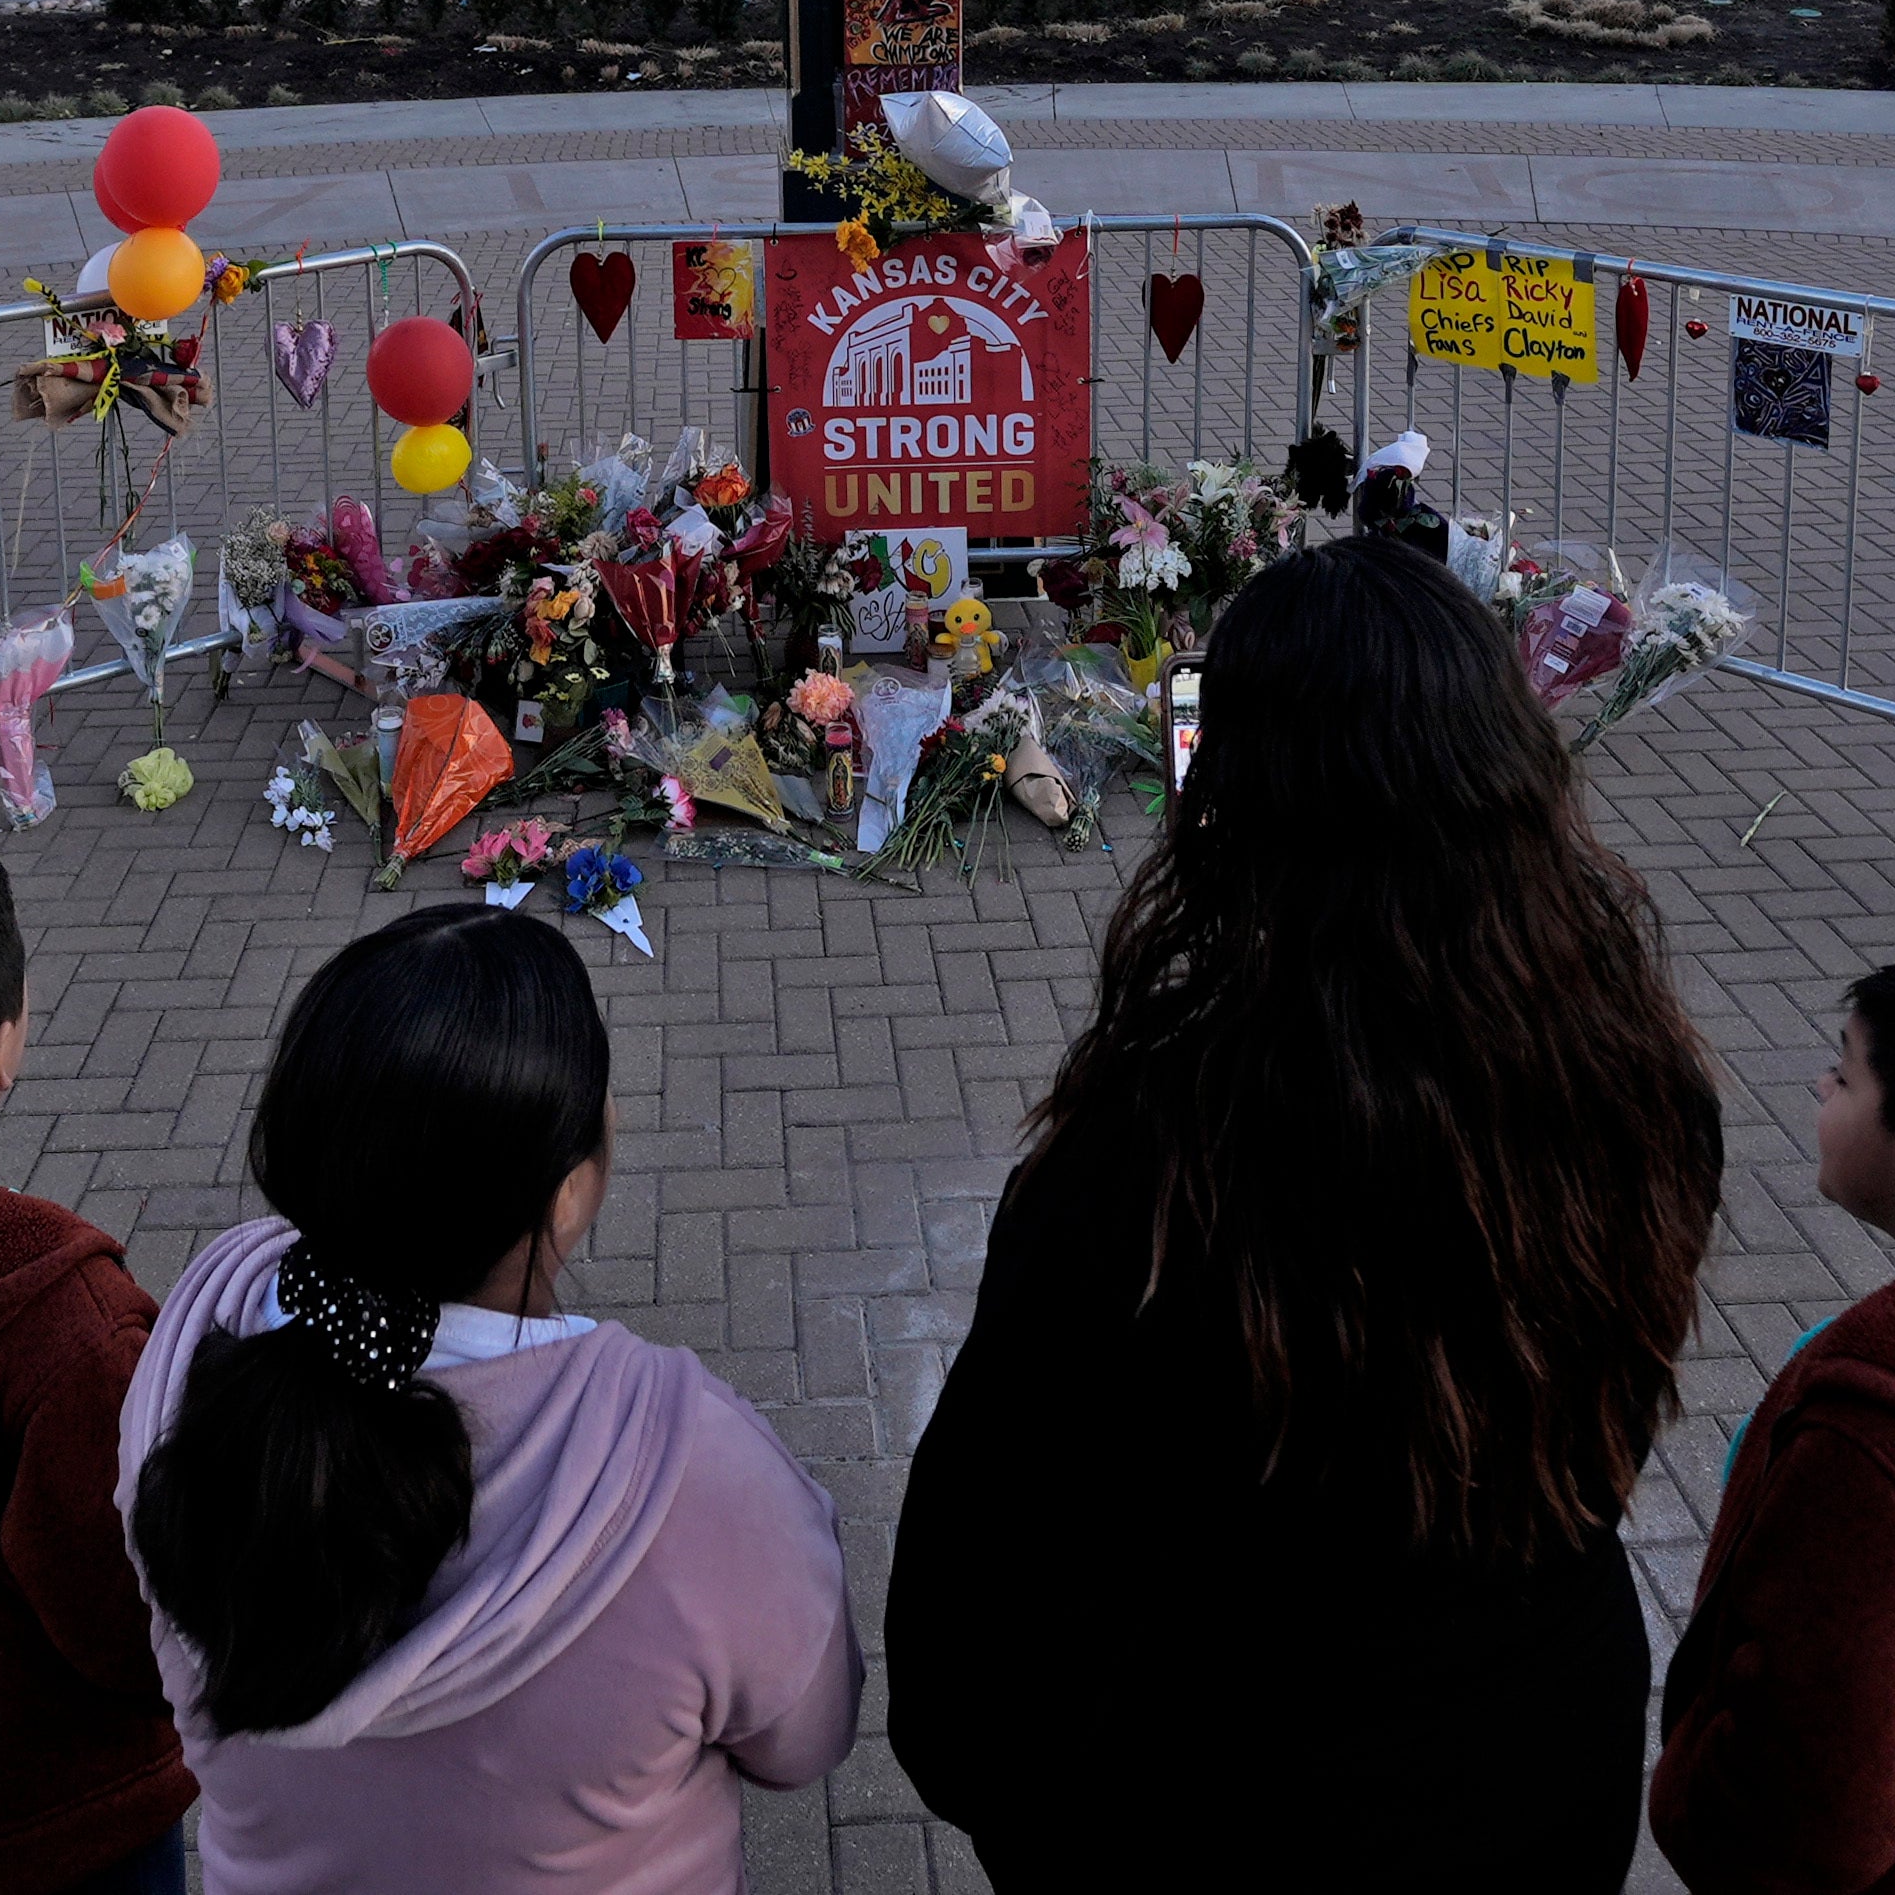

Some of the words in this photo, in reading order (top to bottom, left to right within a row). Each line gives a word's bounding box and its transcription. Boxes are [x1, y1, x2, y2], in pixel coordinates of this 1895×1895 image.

[883, 26, 913, 44] WE
[922, 26, 959, 44] ARE
[871, 42, 957, 65] CHAMPIONS
[685, 245, 708, 268] KC
[807, 255, 958, 336] KANSAS
[967, 265, 1049, 327] CITY
[1420, 272, 1487, 303] Lisa
[1502, 275, 1574, 310] Ricky
[1506, 300, 1573, 329] David
[1736, 317, 1856, 343] RENT-A-FENCE
[1737, 296, 1858, 337] NATIONAL
[1425, 330, 1476, 357] Fans
[1504, 327, 1586, 363] Clayton
[823, 413, 1035, 461] STRONG
[824, 469, 1035, 518] UNITED
